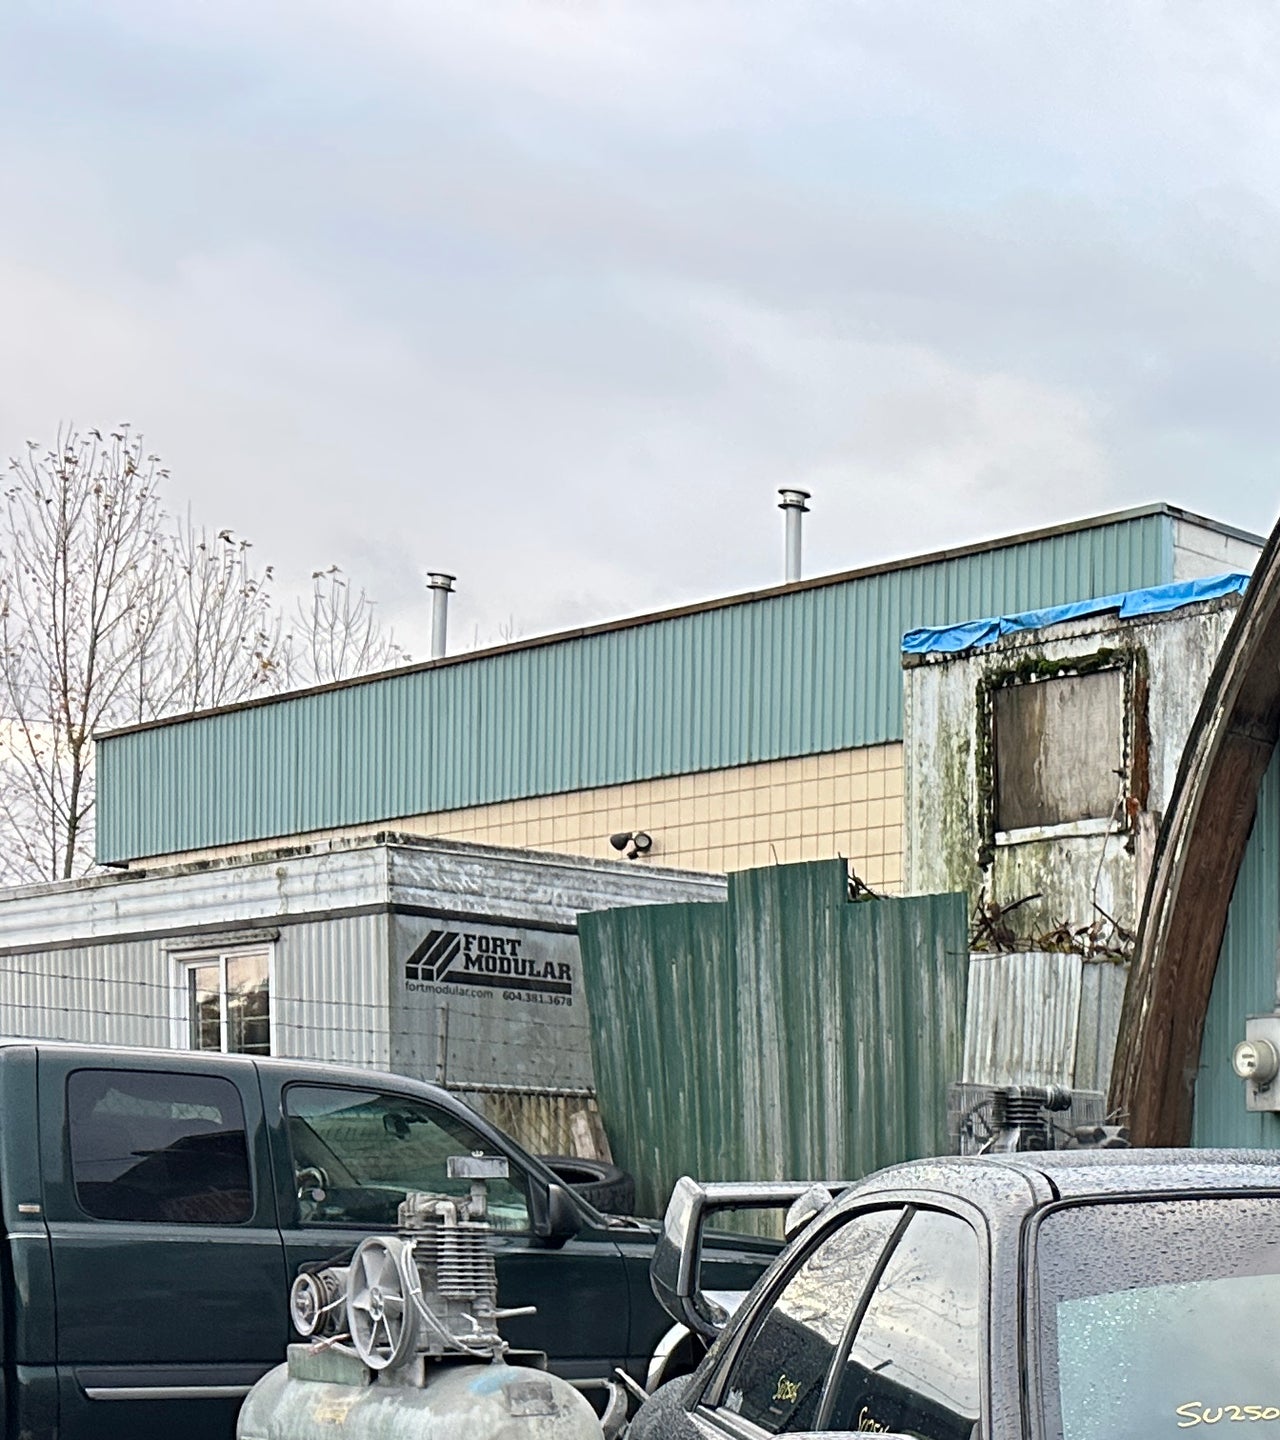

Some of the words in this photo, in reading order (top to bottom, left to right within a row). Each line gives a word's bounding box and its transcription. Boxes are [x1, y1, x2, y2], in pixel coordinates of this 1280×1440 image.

[462, 933, 522, 957] FORT
[462, 952, 572, 981] MODULAR
[405, 981, 494, 999] fortmodular.com
